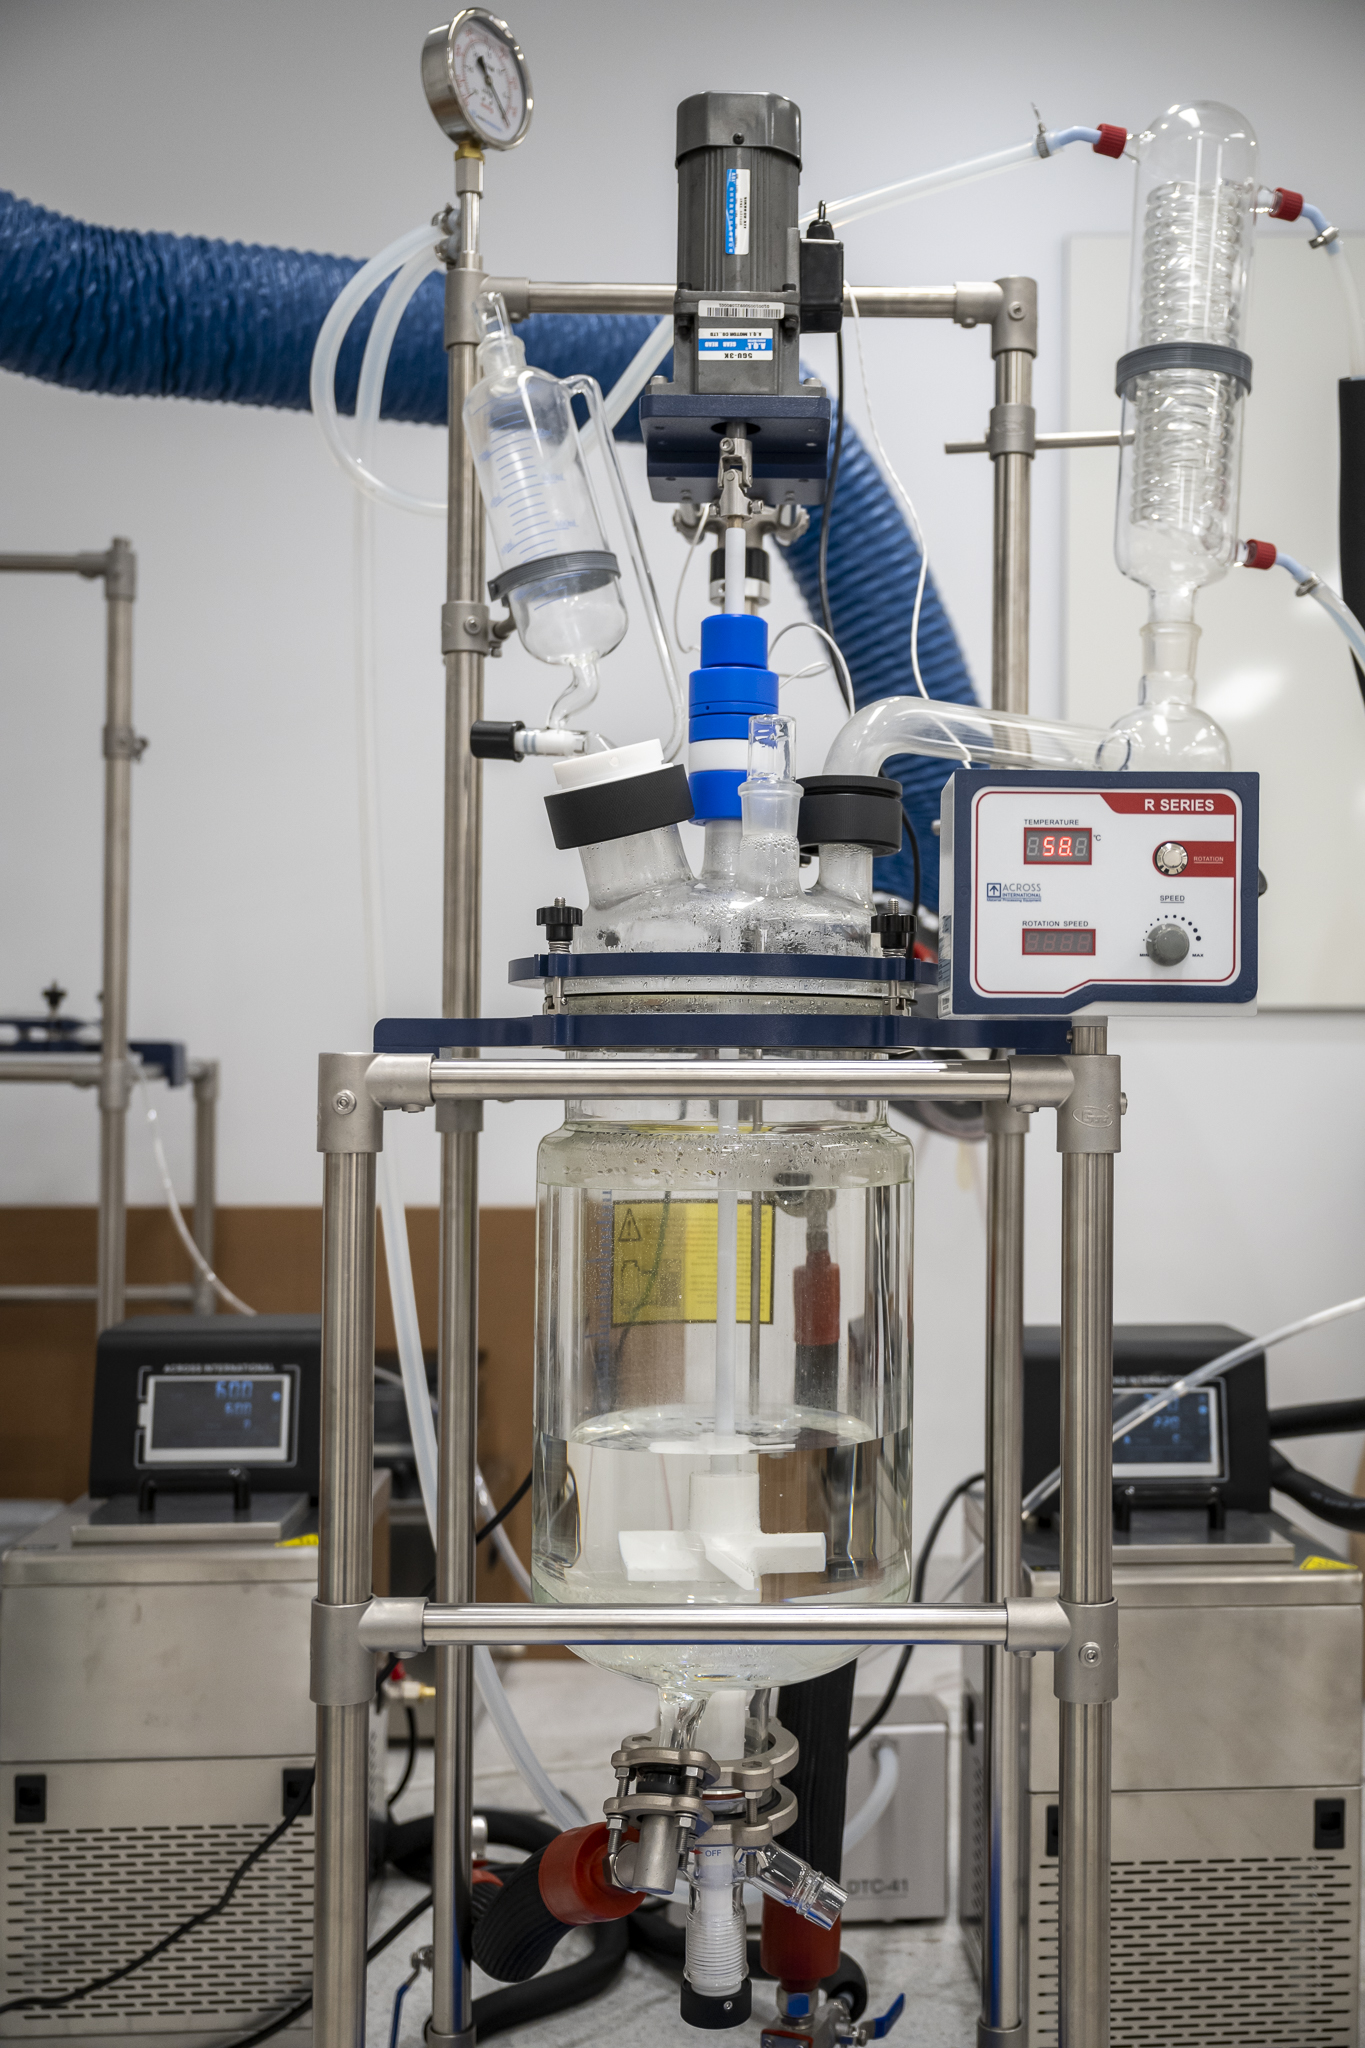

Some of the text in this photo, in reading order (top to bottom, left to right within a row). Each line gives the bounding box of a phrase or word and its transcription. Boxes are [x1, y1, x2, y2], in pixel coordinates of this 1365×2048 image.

[1144, 798, 1215, 812] R SERIES
[1002, 882, 1042, 892] ACROSS
[704, 1849, 722, 1857] OFF
[846, 1878, 909, 1894] DTC-41
